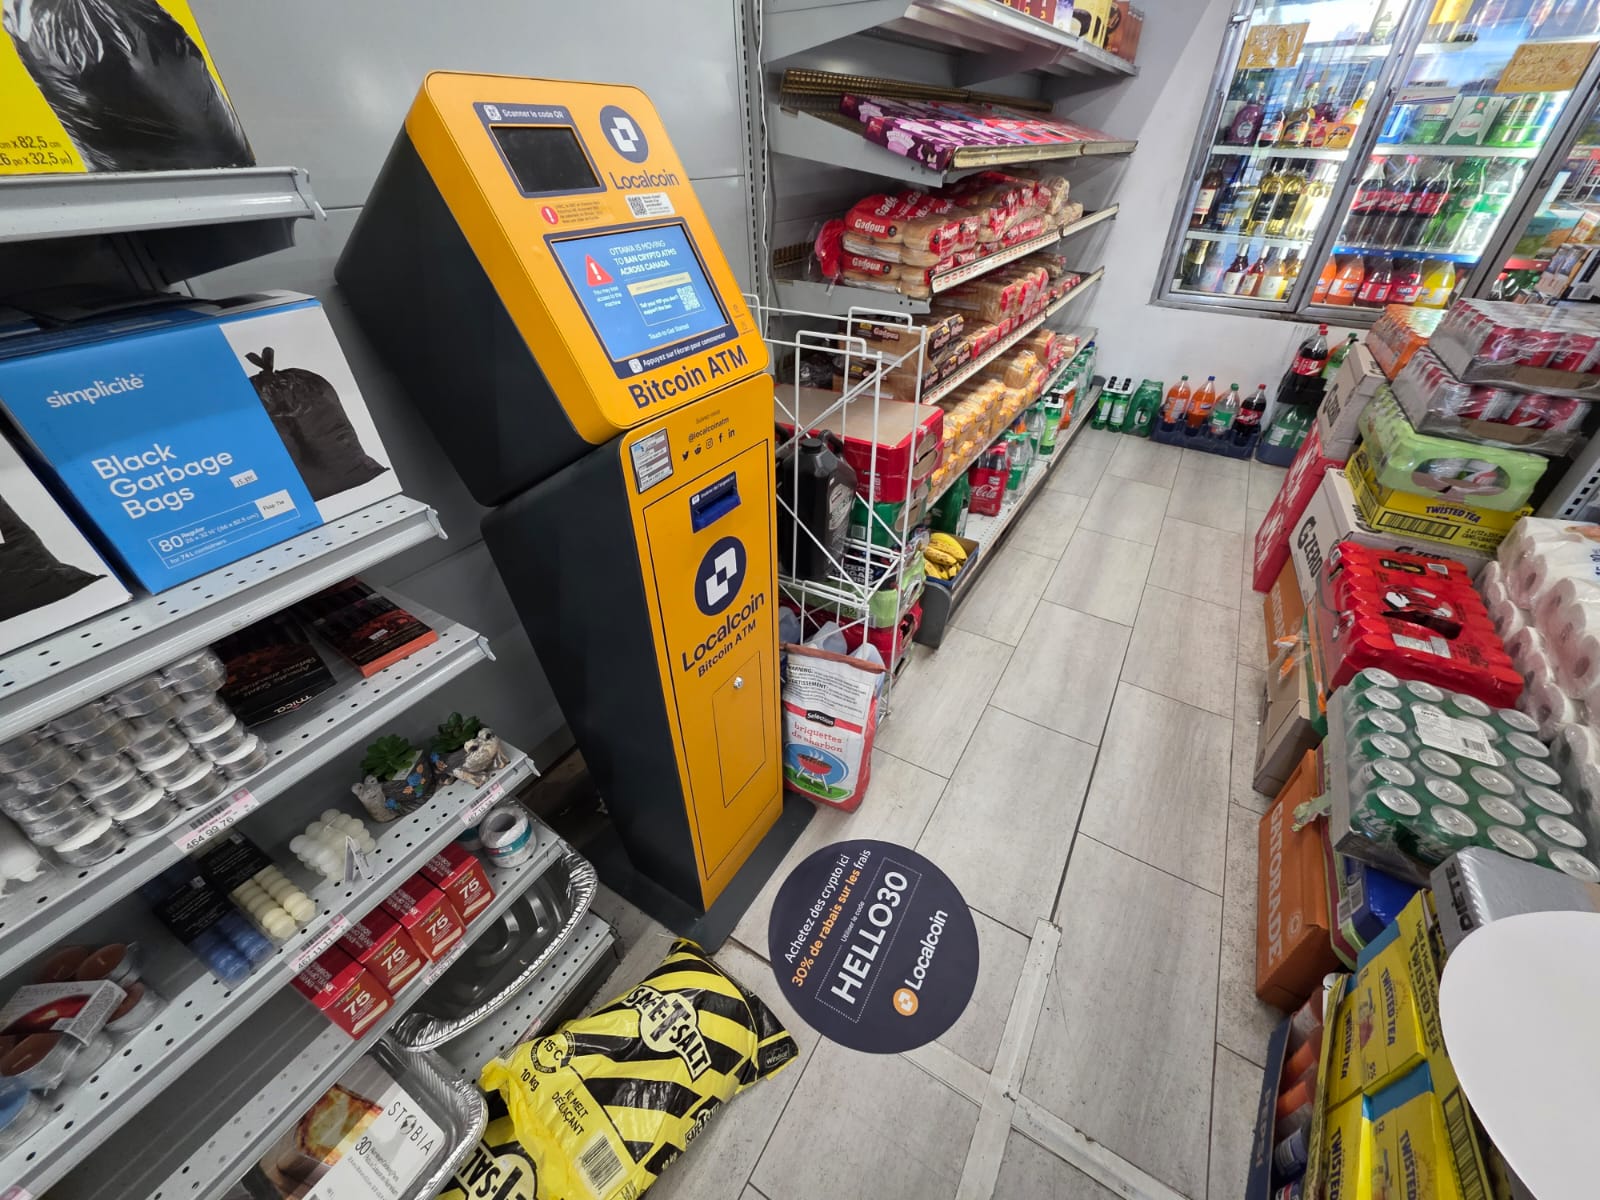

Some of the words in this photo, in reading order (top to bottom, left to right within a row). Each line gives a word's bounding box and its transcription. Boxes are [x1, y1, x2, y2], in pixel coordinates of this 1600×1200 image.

[502, 109, 531, 118] Scanner
[553, 111, 564, 119] QR
[18, 136, 47, 150] 82,5
[29, 152, 59, 166] 32,5
[609, 169, 681, 190] Localcoin
[854, 219, 886, 234] Gadoua
[609, 244, 636, 256] OTTAWA
[642, 240, 666, 251] MOVING
[613, 257, 624, 266] TO
[624, 255, 638, 265] BAN
[638, 250, 661, 262] CRYPTO
[661, 248, 677, 257] ATMS
[620, 265, 645, 276] ACROSS
[646, 260, 671, 271] CANADA
[852, 257, 881, 272] Gadoua
[643, 354, 666, 368] Appuyez
[628, 365, 708, 409] Bitcoin
[707, 344, 749, 379] ATM
[688, 417, 730, 443] @localcoinatm
[91, 443, 177, 480] Black
[109, 452, 233, 498] Garbage
[121, 486, 196, 520] Bags
[1426, 506, 1464, 517] TWISTED
[1464, 512, 1482, 523] TEA
[158, 535, 184, 552] 80
[1297, 515, 1316, 550] G
[1304, 533, 1323, 578] ZERO
[681, 592, 765, 672] Localcoin
[698, 642, 734, 678] Bitcoin
[734, 619, 757, 645] ATM
[274, 695, 312, 714] mica
[791, 731, 802, 741] de
[803, 736, 843, 753] charbon
[794, 722, 843, 744] briquettes
[186, 835, 205, 850] 464
[205, 825, 220, 837] 99
[220, 816, 234, 827] 76
[854, 849, 871, 870] frais
[459, 879, 481, 899] 75
[848, 868, 861, 886] les
[1268, 802, 1283, 966] GATORADE
[838, 885, 852, 904] sur
[1445, 863, 1474, 932] DIÈTE
[785, 917, 815, 964] Achetez
[810, 898, 826, 919] des
[822, 866, 844, 899] crypto
[836, 853, 850, 869] ici
[851, 913, 858, 922] le
[855, 901, 865, 916] code
[425, 914, 449, 938] 75
[821, 904, 843, 940] rabais
[809, 938, 823, 957] de
[830, 871, 908, 1005] HELLO30
[904, 910, 949, 990] Localcoin
[381, 947, 407, 971] 75
[792, 955, 815, 987] 30%
[343, 990, 370, 1016] 75
[1380, 967, 1395, 1018] TWISTED
[1409, 938, 1429, 1016] TWISTED
[1423, 1016, 1440, 1054] TEA
[1386, 1018, 1396, 1046] TEA
[1340, 1052, 1350, 1080] TEA
[520, 1068, 531, 1083] 10
[528, 1076, 540, 1092] kg
[571, 1095, 589, 1120] MELT
[355, 1136, 372, 1156] 30
